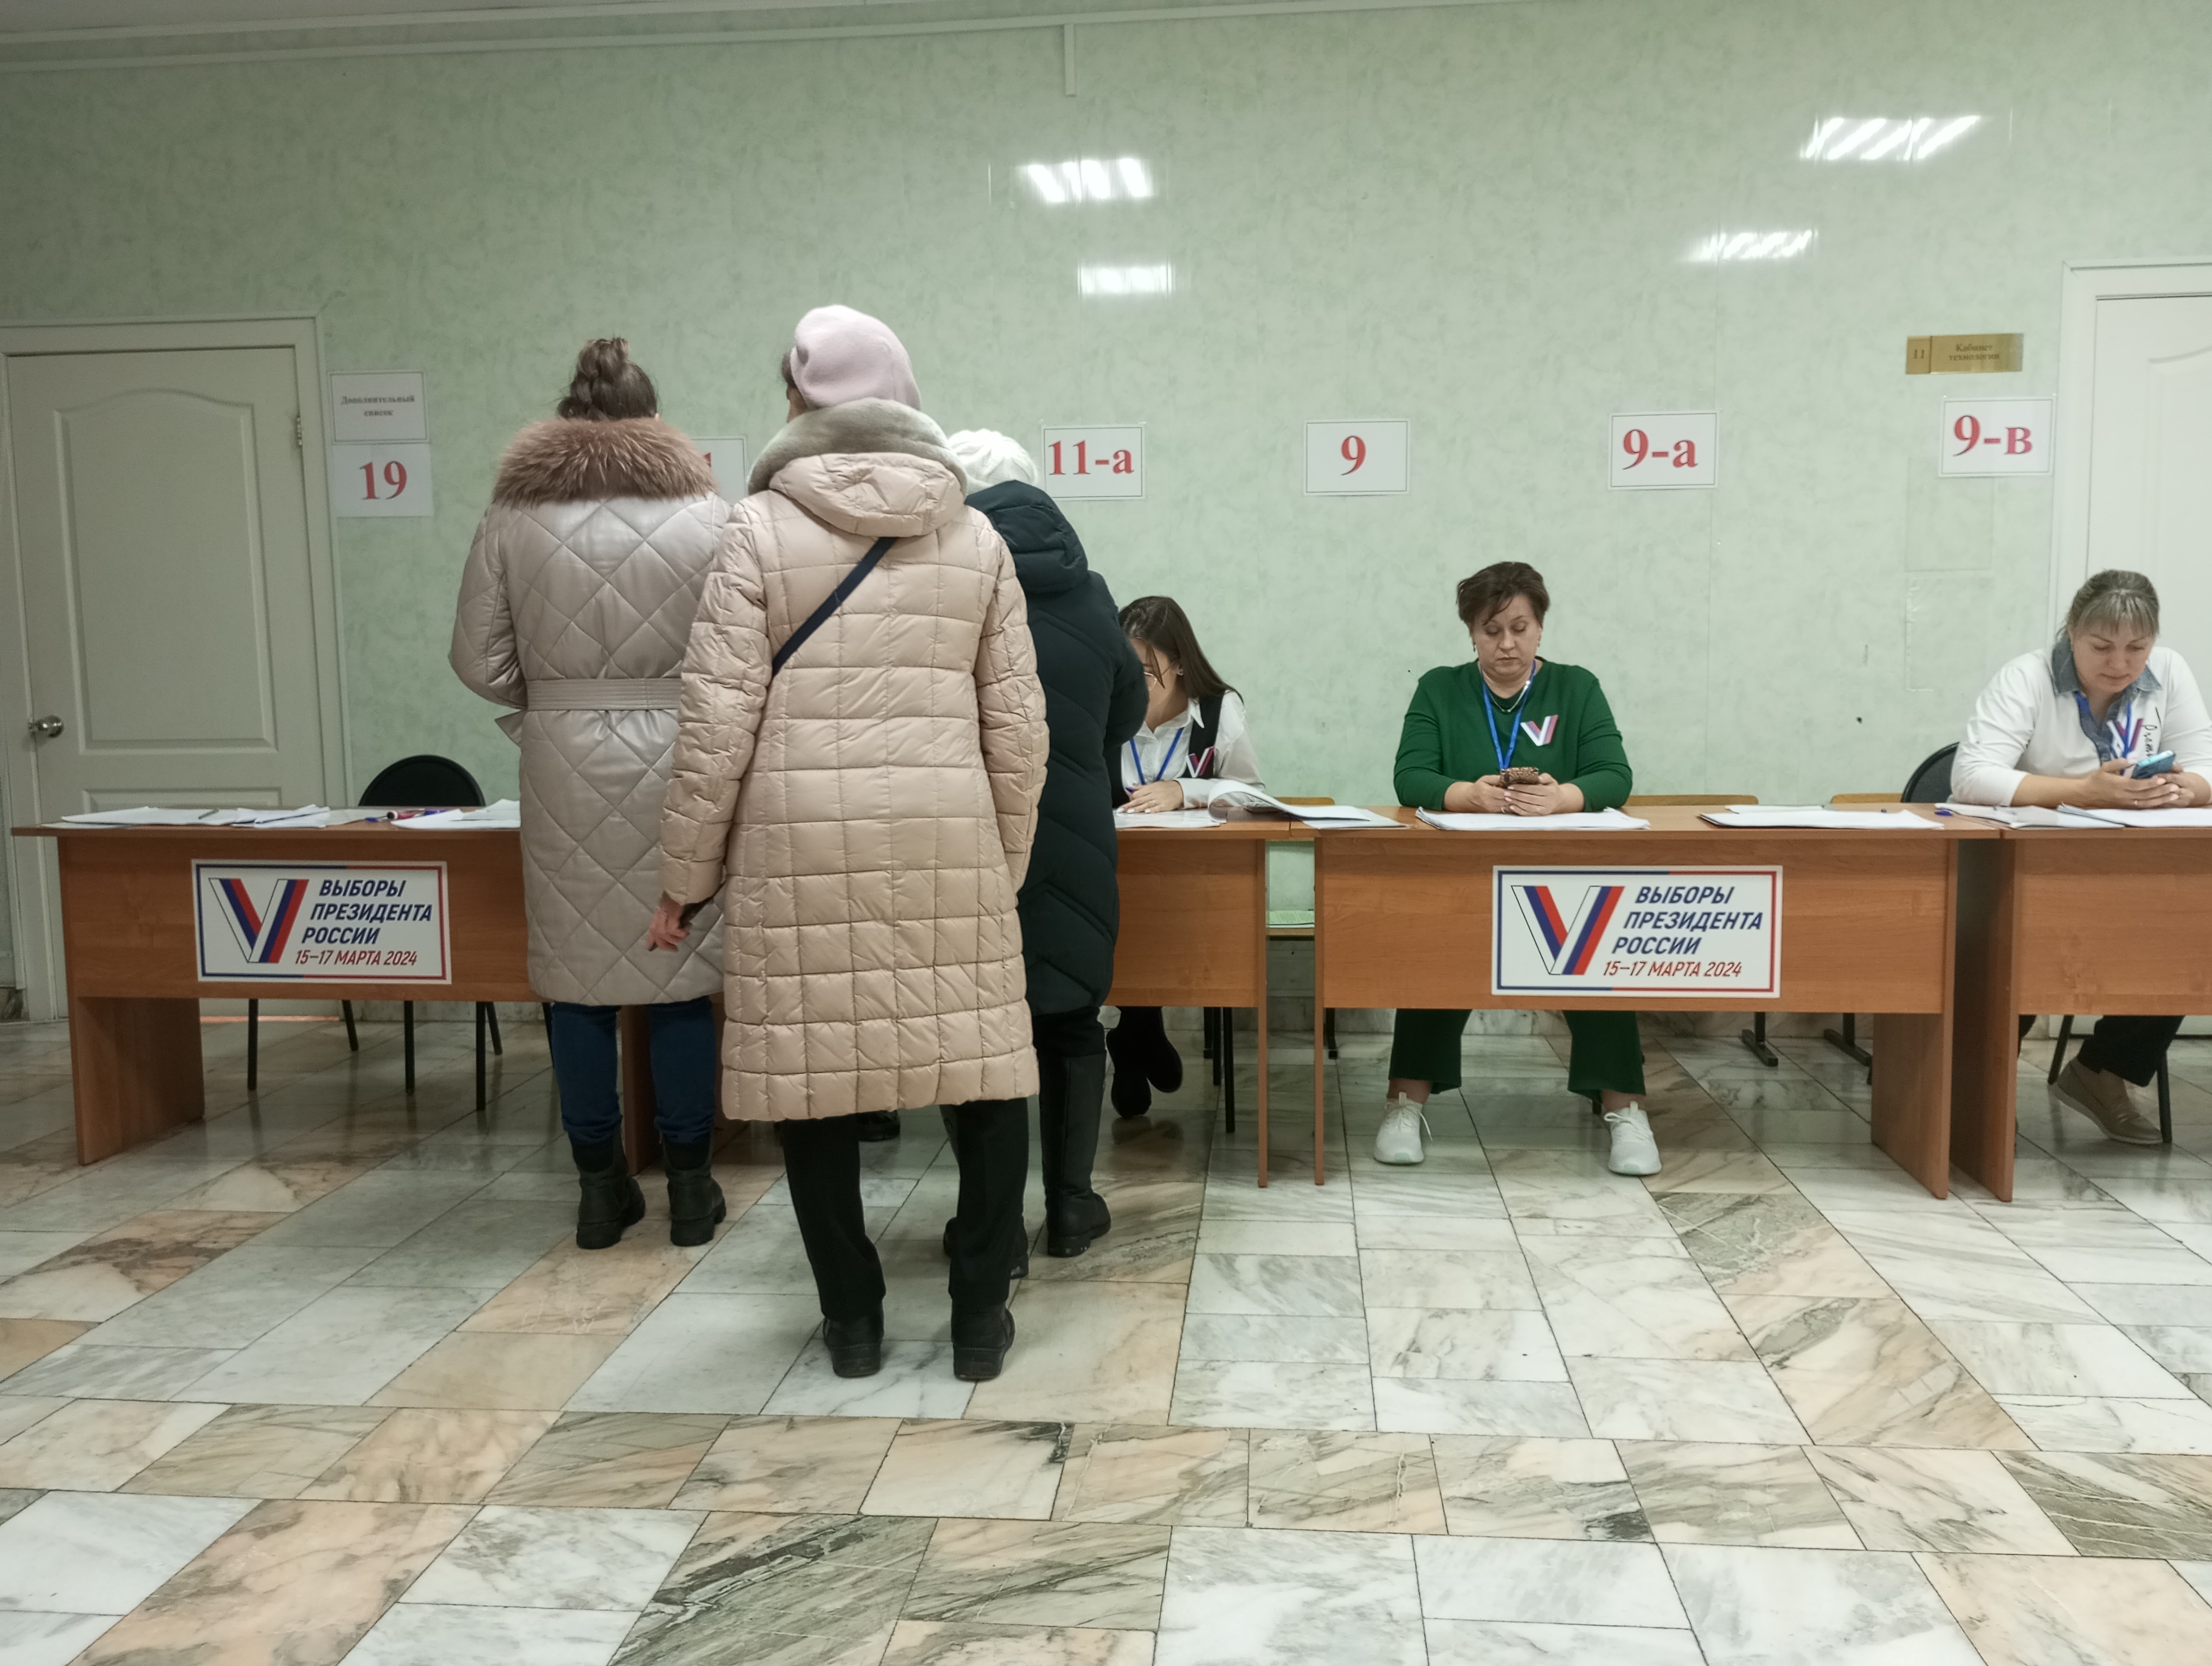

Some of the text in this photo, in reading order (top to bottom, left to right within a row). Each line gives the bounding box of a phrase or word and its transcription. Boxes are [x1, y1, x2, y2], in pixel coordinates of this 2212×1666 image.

[342, 395, 415, 405] Дополнительный
[1049, 440, 1134, 475] 11-а
[1340, 435, 1366, 476] 9
[1623, 429, 1698, 470] 9-а
[359, 460, 407, 499] 19
[319, 879, 407, 897] ВЫБОРЫ
[1634, 886, 1735, 905] ВЫБОРЫ
[310, 903, 433, 924] ПРЕЗИДЕНТА
[1623, 911, 1764, 932] ПРЕЗИДЕНТА
[301, 926, 381, 945] РОССИИ
[1611, 937, 1702, 954] РОССИИ
[334, 950, 381, 965] МАРТА
[383, 951, 417, 966] 2024
[1648, 962, 1700, 977] МАРТА
[1703, 962, 1742, 978] 2024
